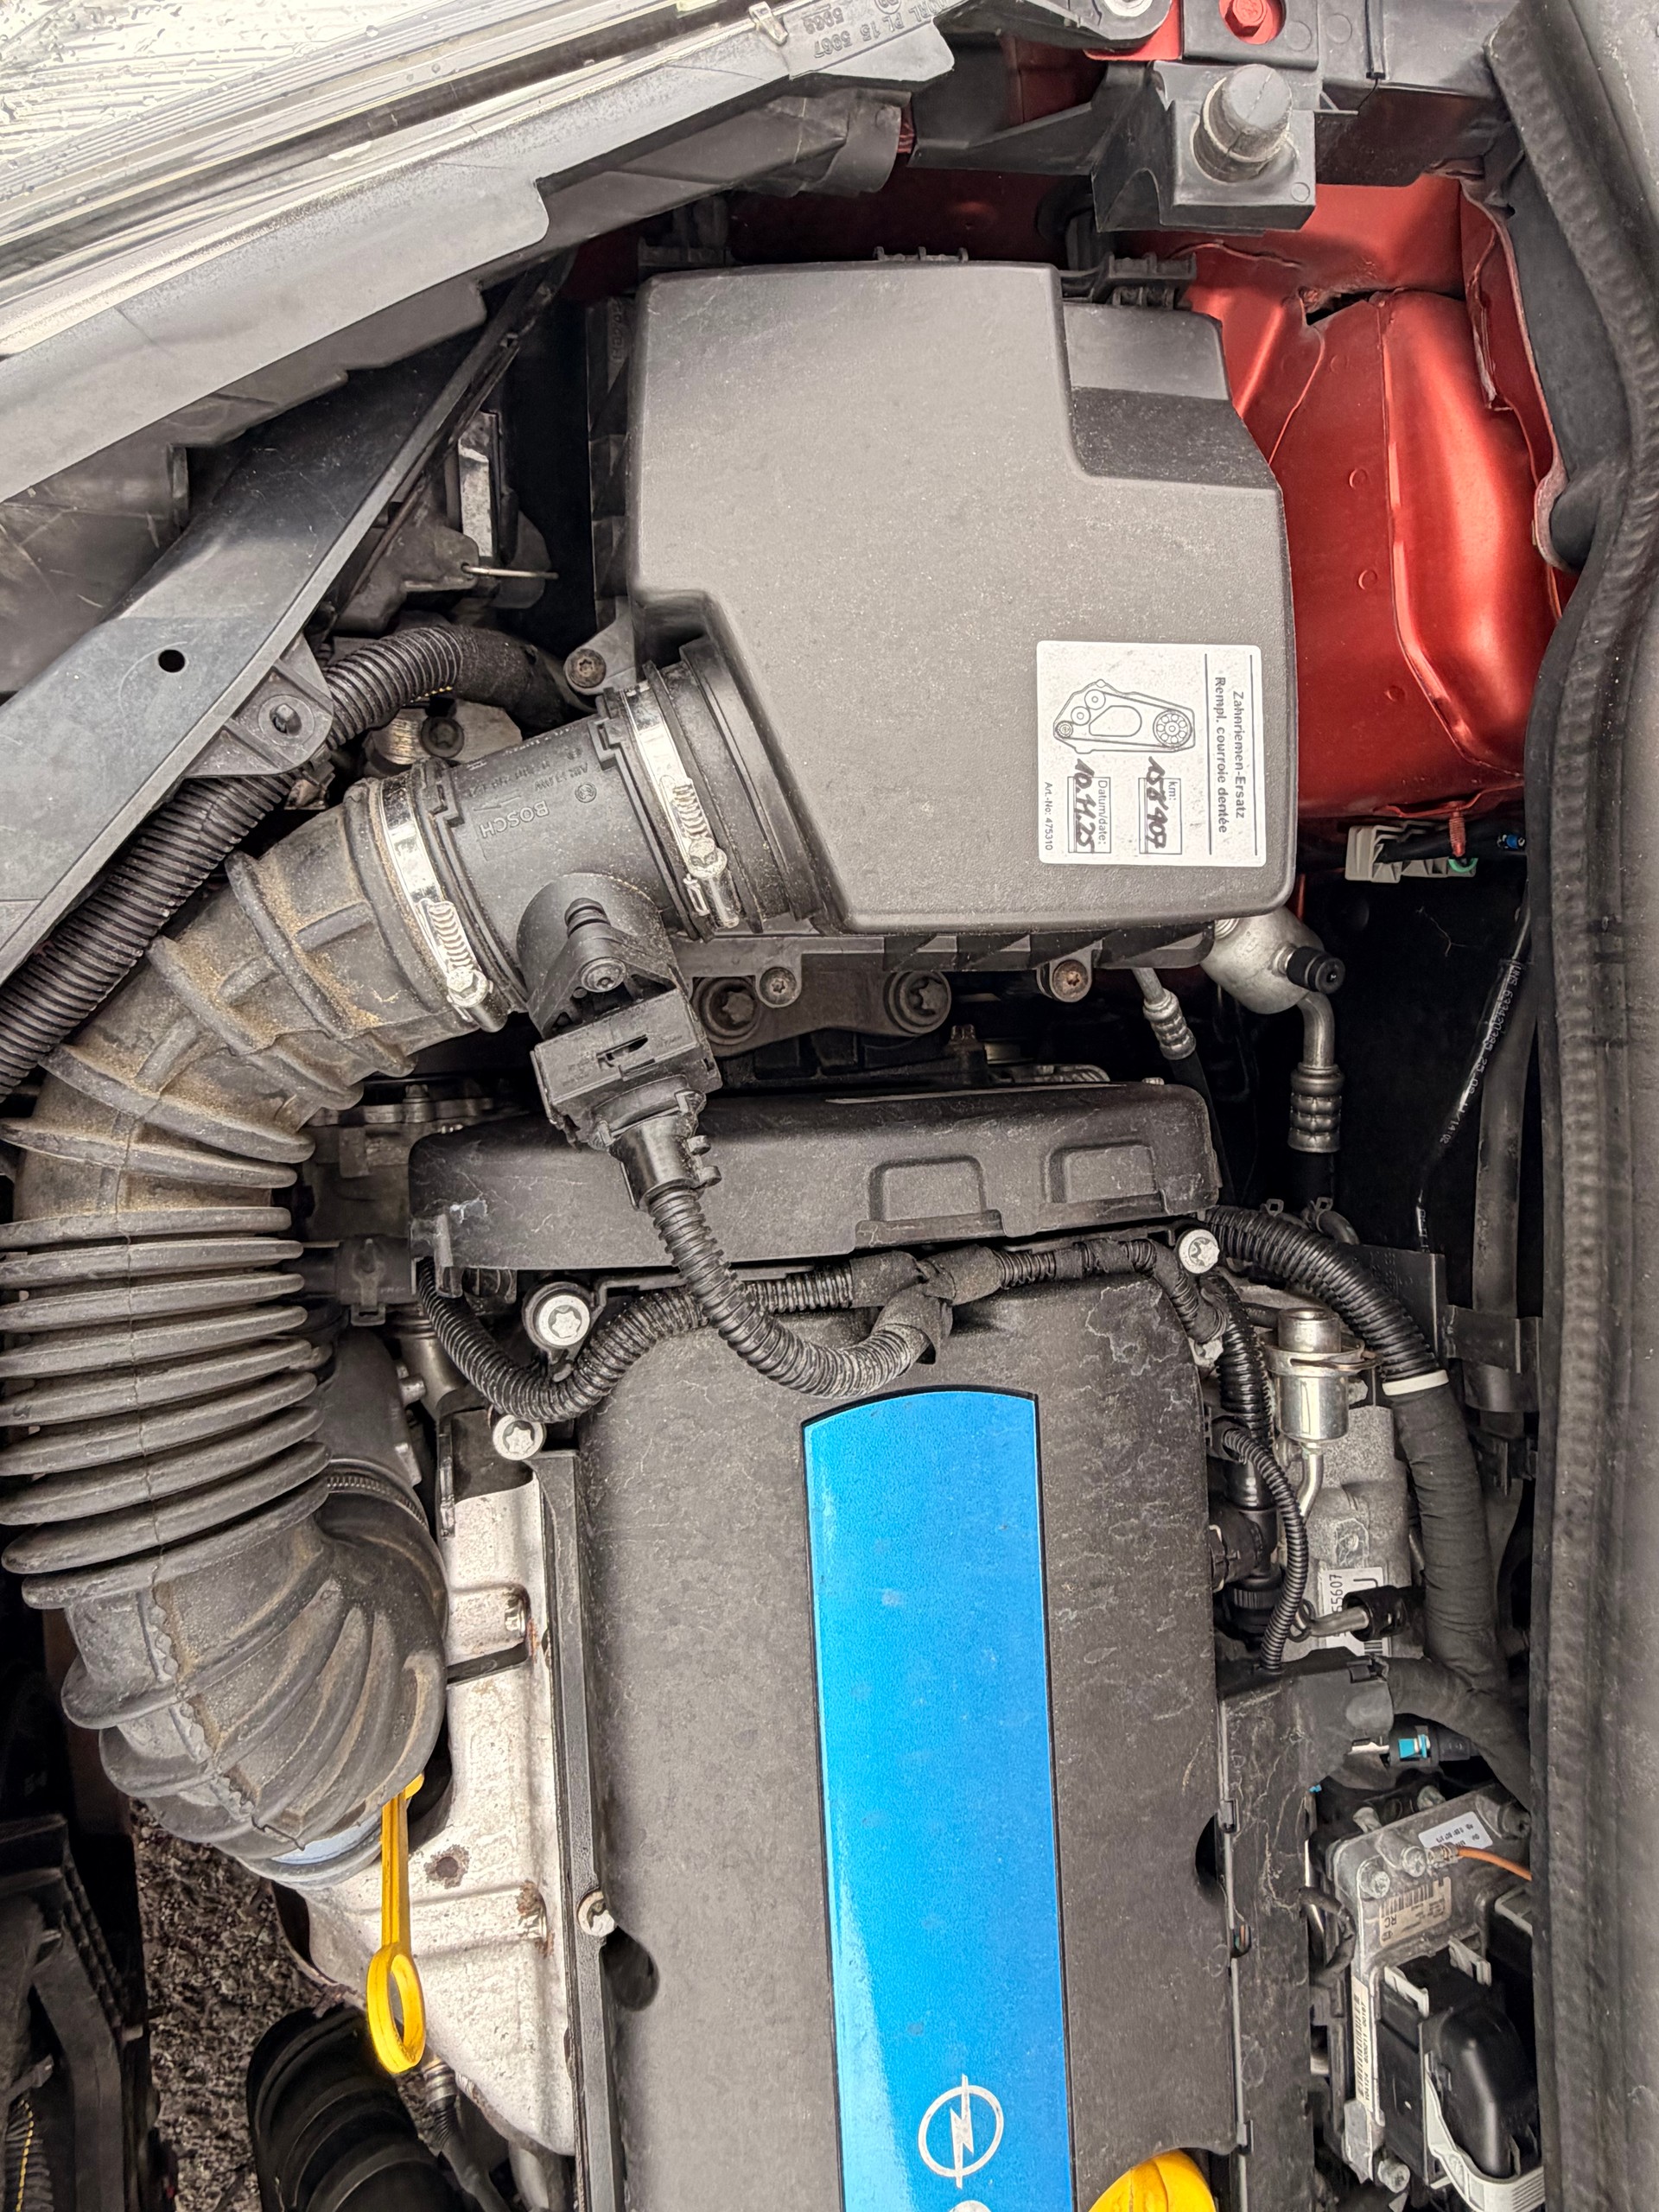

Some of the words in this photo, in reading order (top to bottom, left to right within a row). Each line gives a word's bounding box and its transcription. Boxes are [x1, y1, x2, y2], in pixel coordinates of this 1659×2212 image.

[859, 21, 881, 42] 15
[882, 12, 906, 33] PL
[1213, 677, 1227, 723] Rempl.
[1216, 728, 1228, 784] courroie
[1232, 690, 1247, 819] Zahnriemen-Ersatz
[1168, 781, 1179, 801] km:
[1218, 787, 1230, 834] dentée
[479, 800, 550, 839] BOSCH
[1097, 779, 1109, 846] Datum/date:
[1045, 817, 1054, 851] 475310
[1383, 1914, 1397, 1929] RC
